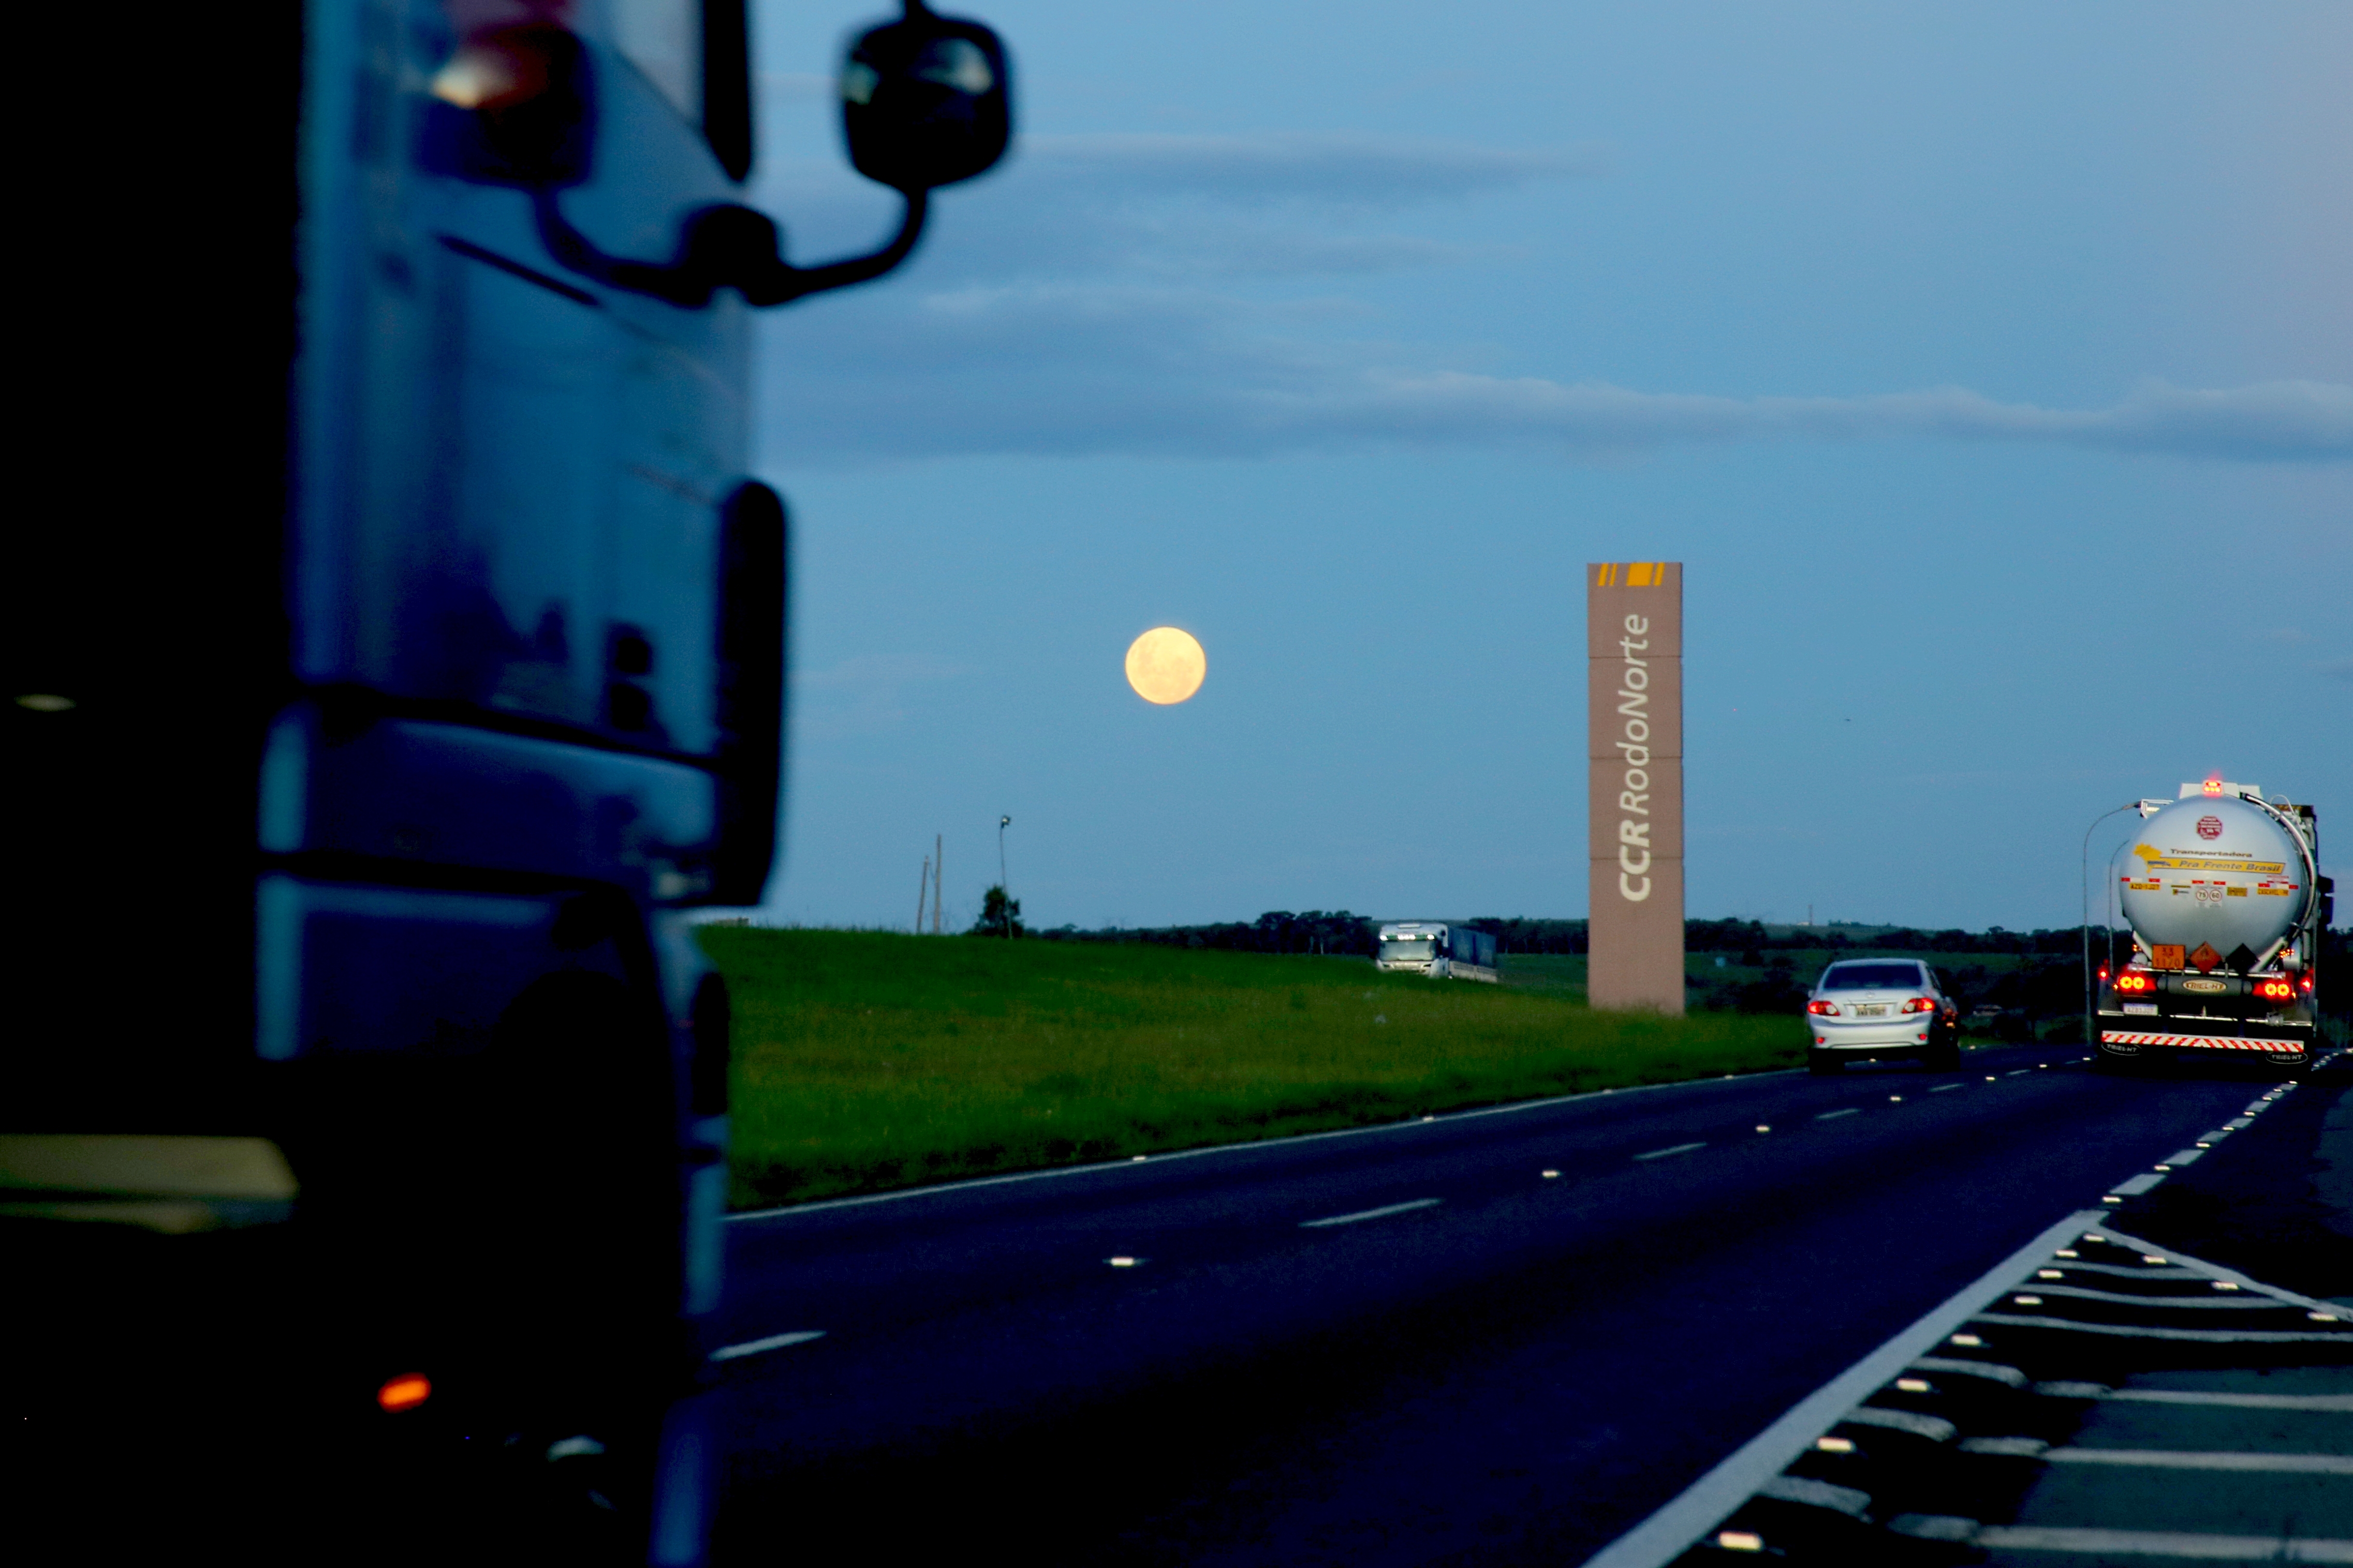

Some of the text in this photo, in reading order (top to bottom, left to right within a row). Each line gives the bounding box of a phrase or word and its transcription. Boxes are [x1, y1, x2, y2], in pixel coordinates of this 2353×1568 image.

[1615, 614, 1651, 902] CCR RodoNorte
[2170, 849, 2253, 857] Transportadora
[2203, 861, 2242, 869] Frente
[2246, 863, 2281, 871] Brasil
